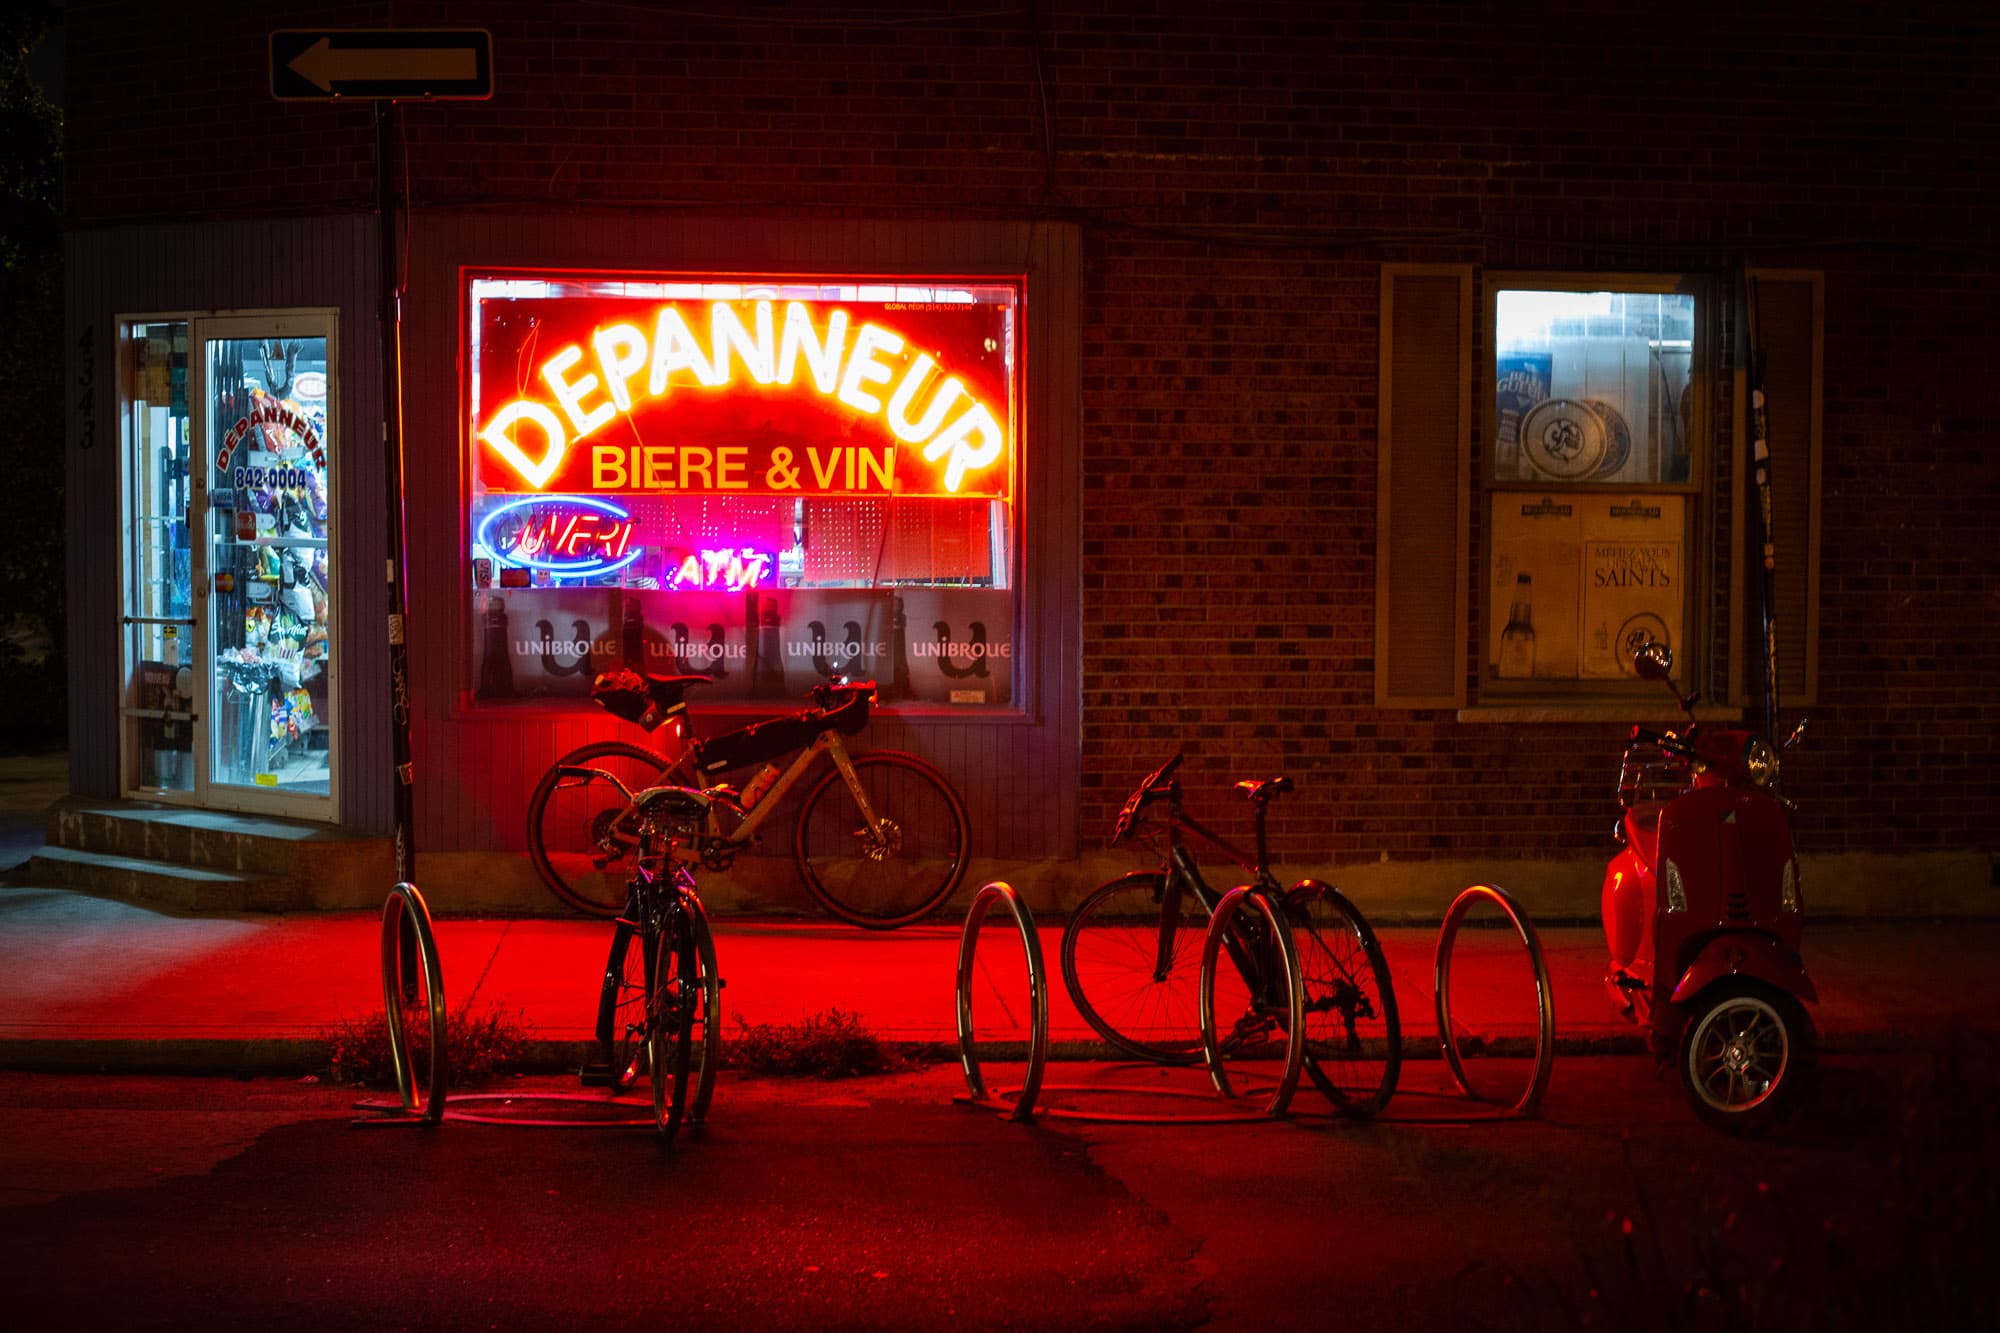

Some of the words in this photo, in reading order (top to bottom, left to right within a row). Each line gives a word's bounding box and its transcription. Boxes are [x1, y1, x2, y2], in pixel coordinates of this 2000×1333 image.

[478, 300, 1004, 491] DEPANNEUR
[235, 467, 306, 490] 842-0004
[592, 445, 749, 489] BIERE
[765, 445, 801, 489] &
[806, 445, 894, 489] VIN
[674, 548, 764, 590] ATM
[1594, 567, 1671, 588] SAINTS
